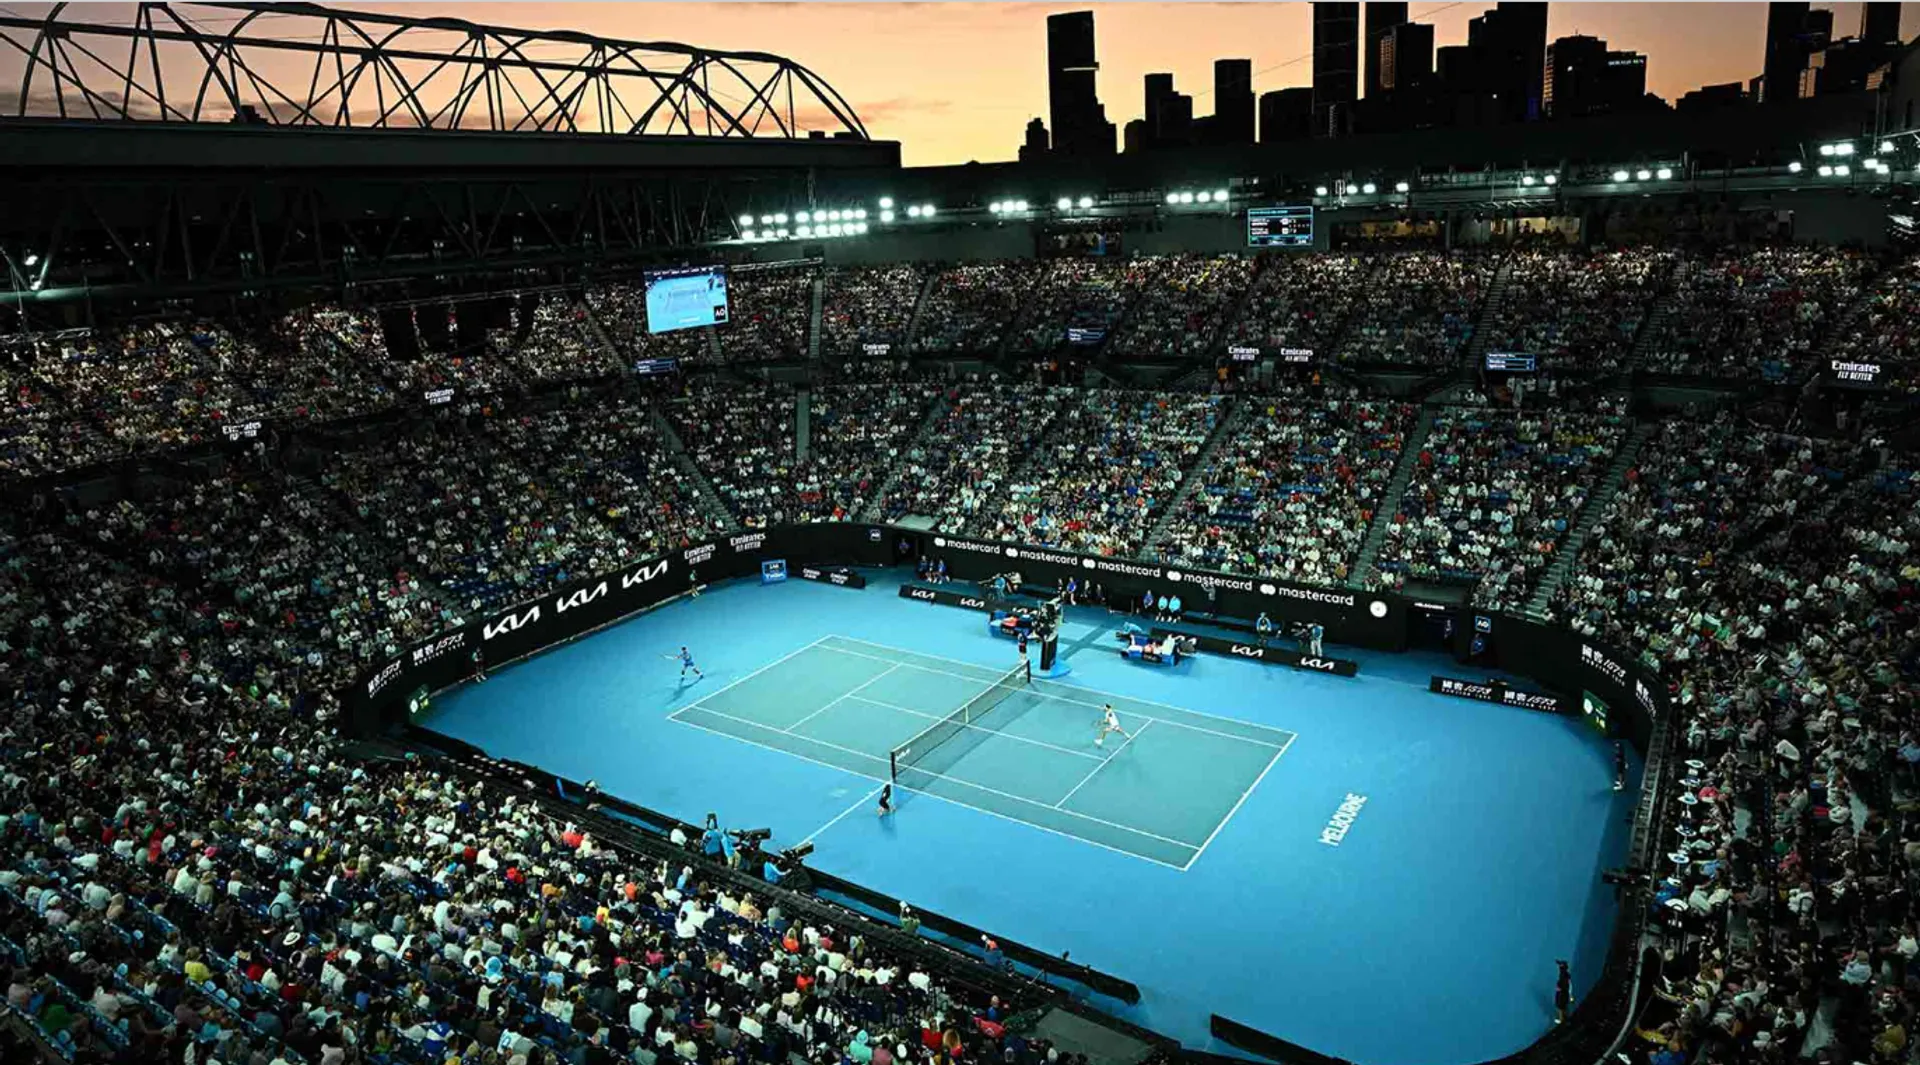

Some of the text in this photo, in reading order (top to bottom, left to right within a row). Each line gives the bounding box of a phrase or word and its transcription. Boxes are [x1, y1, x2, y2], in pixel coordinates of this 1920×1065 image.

[1831, 360, 1881, 374] Emirates
[729, 533, 766, 546] Emirates
[947, 539, 1001, 554] mastercard
[1020, 550, 1078, 566] mastercard
[622, 560, 667, 589] KIA
[1098, 561, 1161, 578] mastercard
[1183, 574, 1253, 591] mastercard
[556, 581, 607, 613] KIA
[1278, 587, 1354, 606] mastercard
[483, 605, 540, 640] KIA
[1316, 792, 1368, 847] MELBOURNE
